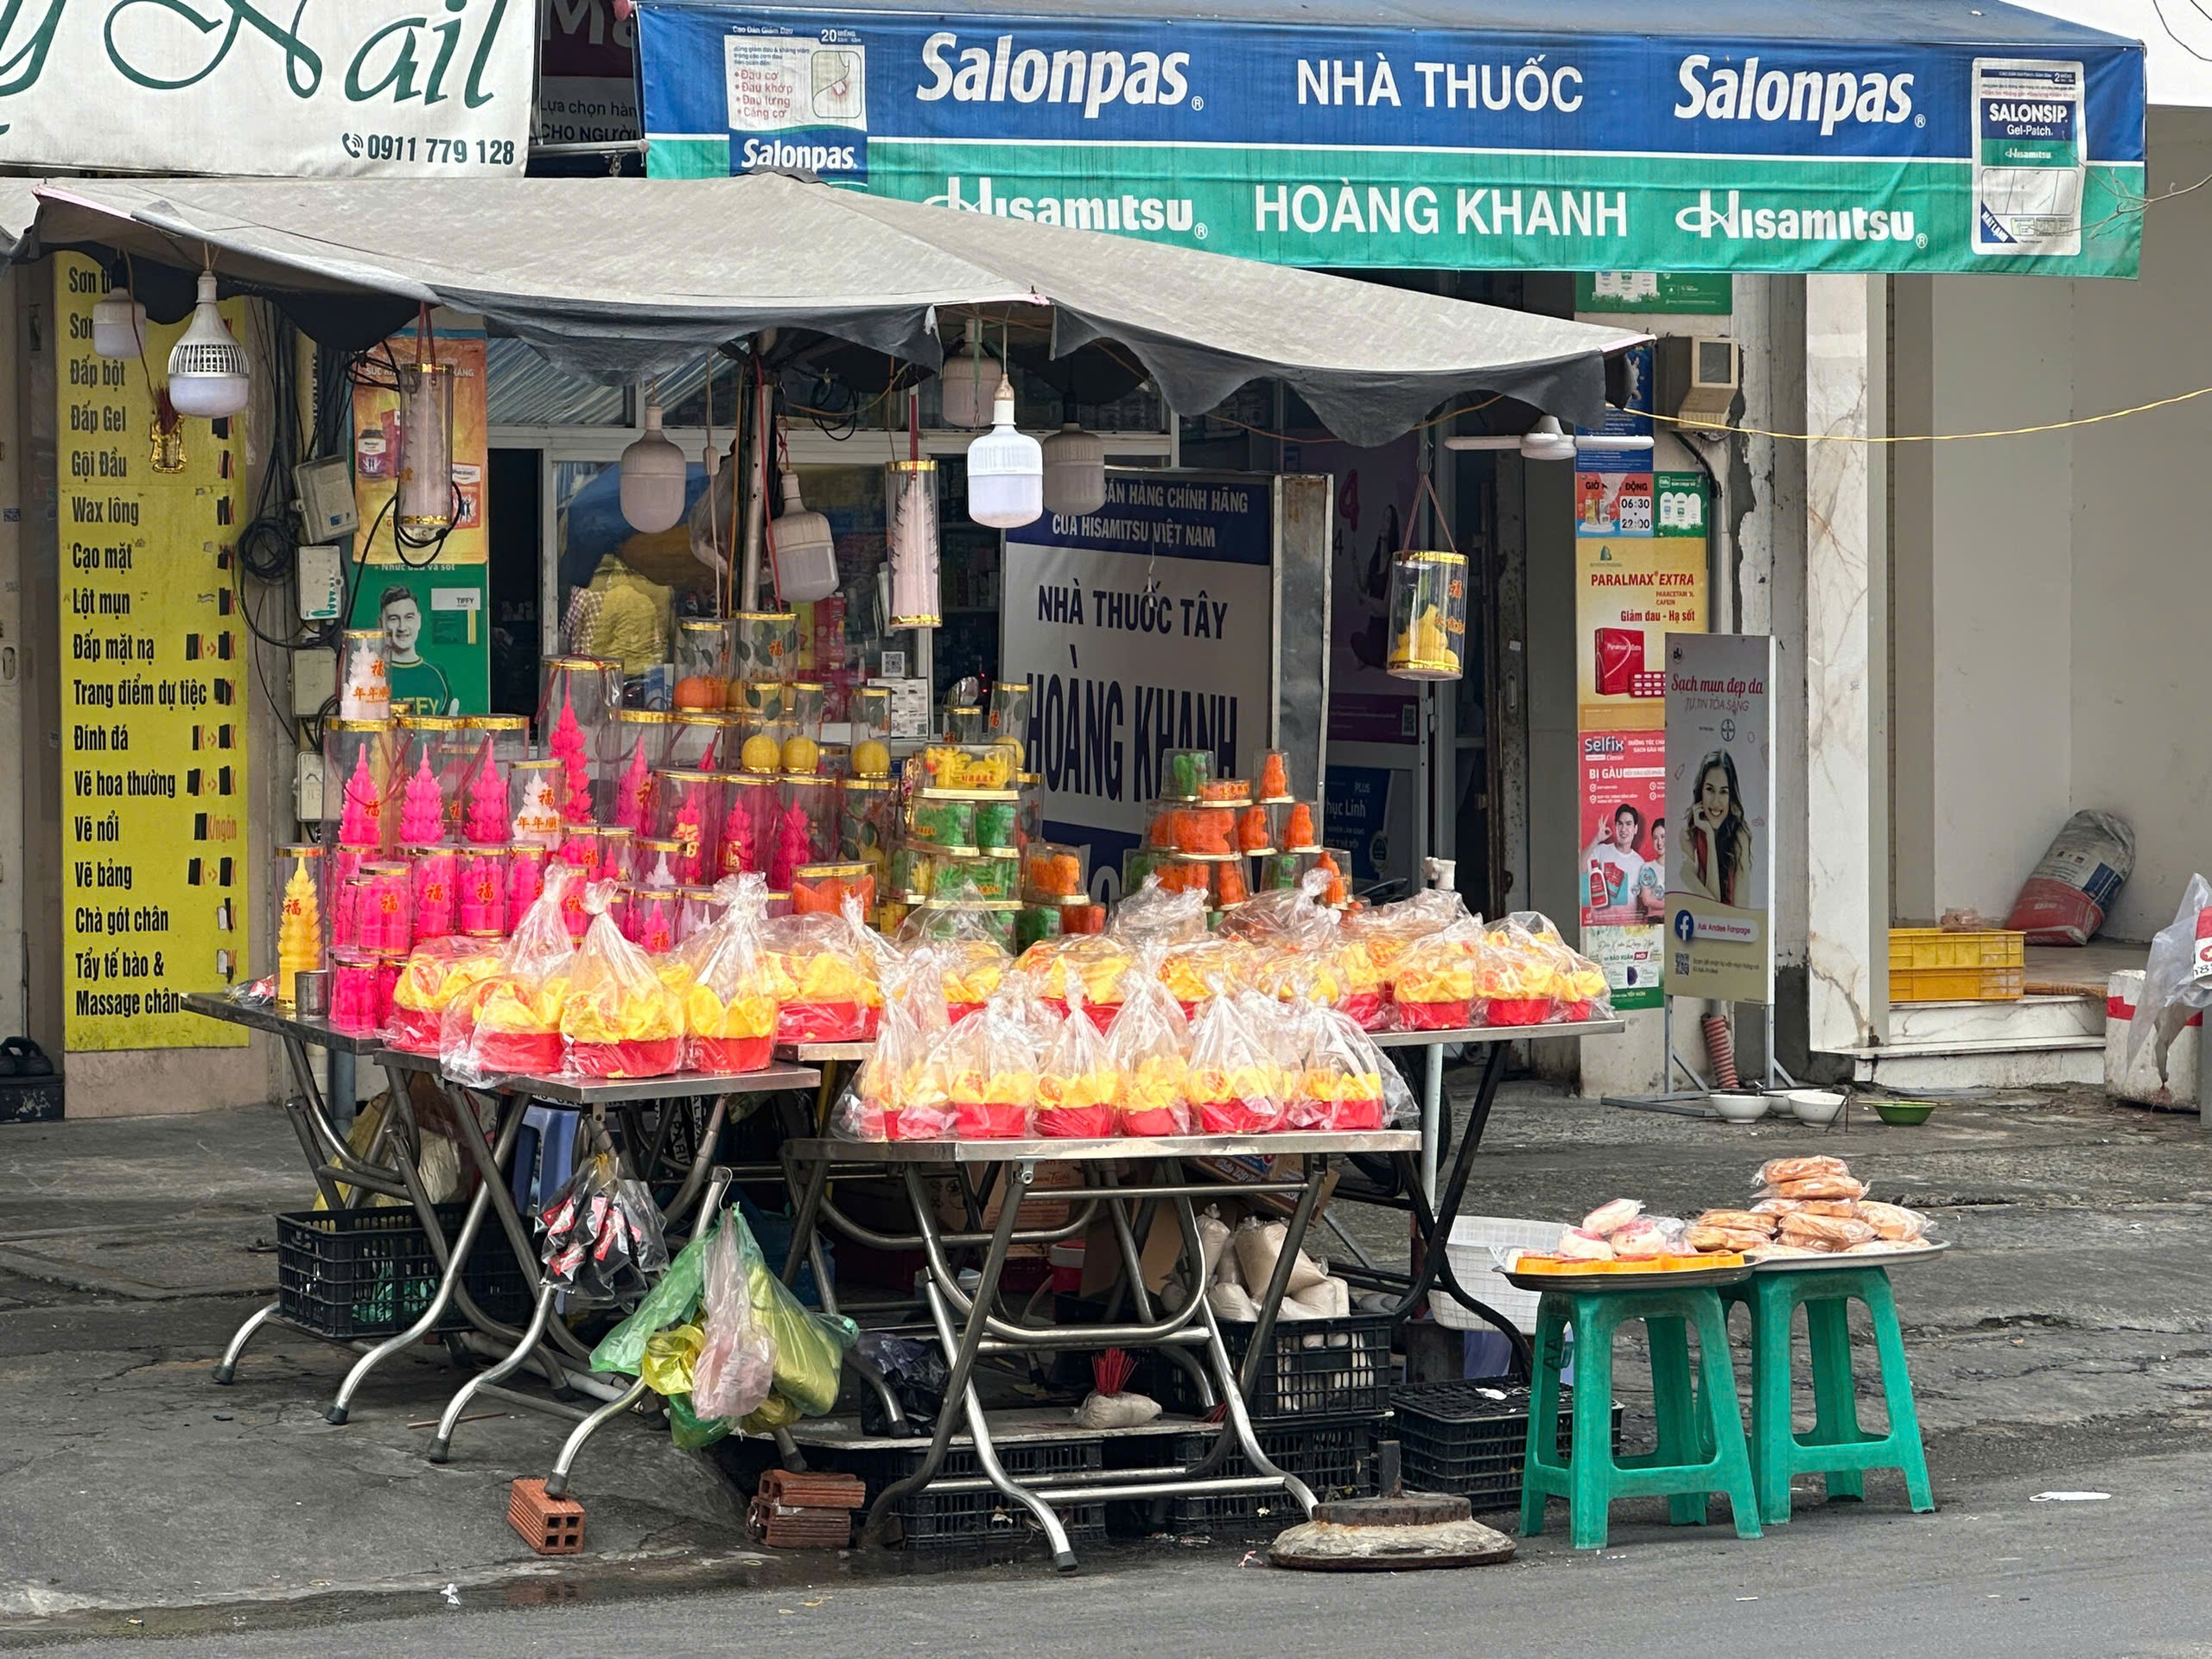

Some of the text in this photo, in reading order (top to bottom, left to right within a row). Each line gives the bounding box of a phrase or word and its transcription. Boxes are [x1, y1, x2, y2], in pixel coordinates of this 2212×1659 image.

[821, 29, 837, 42] 20
[916, 32, 1915, 136] Salonpas NHÀ THUỐC Salonpas
[569, 99, 606, 118] chọn
[611, 100, 638, 118] hàn
[1989, 102, 2067, 123] SALONSIP
[2006, 124, 2051, 137] Gel-Patch
[366, 134, 515, 166] 0911 779 128
[741, 138, 855, 175] Salonpas
[2005, 147, 2052, 159] Hisamitsu
[1255, 177, 1438, 235] HOÀNG
[1457, 188, 1627, 238] KHANH
[1675, 189, 1915, 241] Hisamitsu
[69, 266, 96, 294] Sơn
[103, 359, 125, 391] bột
[103, 405, 126, 432] Gel
[72, 448, 127, 480] Gội Đầu
[1128, 479, 1248, 513] HÀNG CHÍNH HÃNG
[1625, 481, 1648, 493] ĐỘNG
[72, 496, 139, 527] Wax lông
[1621, 499, 1649, 509] 06:30
[1081, 516, 1216, 548] HISAMITSU VIỆT NAM
[73, 543, 132, 575] Cạo mặt
[1591, 574, 1694, 586] PARALMAX EXTRA
[73, 588, 130, 620] Lột mụn
[1038, 578, 1228, 640] NHÀ THUỐC TÂY
[1620, 608, 1694, 623] Giảm đau Hạ sốt
[73, 628, 101, 661] Đấp
[105, 633, 133, 665] mặt
[136, 639, 155, 665] nạ
[73, 679, 113, 708] Trang
[118, 674, 154, 705] điểm
[158, 679, 176, 710] dự
[180, 678, 207, 710] tiệc
[1671, 674, 1764, 698] Sạch mụn đẹp da
[73, 725, 129, 751] Đính đá
[1025, 644, 1123, 802] HOÀNG
[1585, 736, 1624, 753] Selfix
[74, 770, 92, 796] Vẽ
[97, 771, 123, 796] hoa
[127, 769, 175, 798] thường
[1589, 768, 1599, 782] BỊ
[1602, 766, 1623, 779] GÀU
[1326, 797, 1365, 819] hục Linh
[74, 812, 237, 842] Vẽ nổi K/ngón
[74, 859, 132, 891] Vẽ bảng
[75, 905, 168, 936] Chà gót chân
[285, 899, 302, 916] 福
[76, 948, 164, 981] Tẩy tế bào &
[76, 987, 180, 1017] Massage chân
